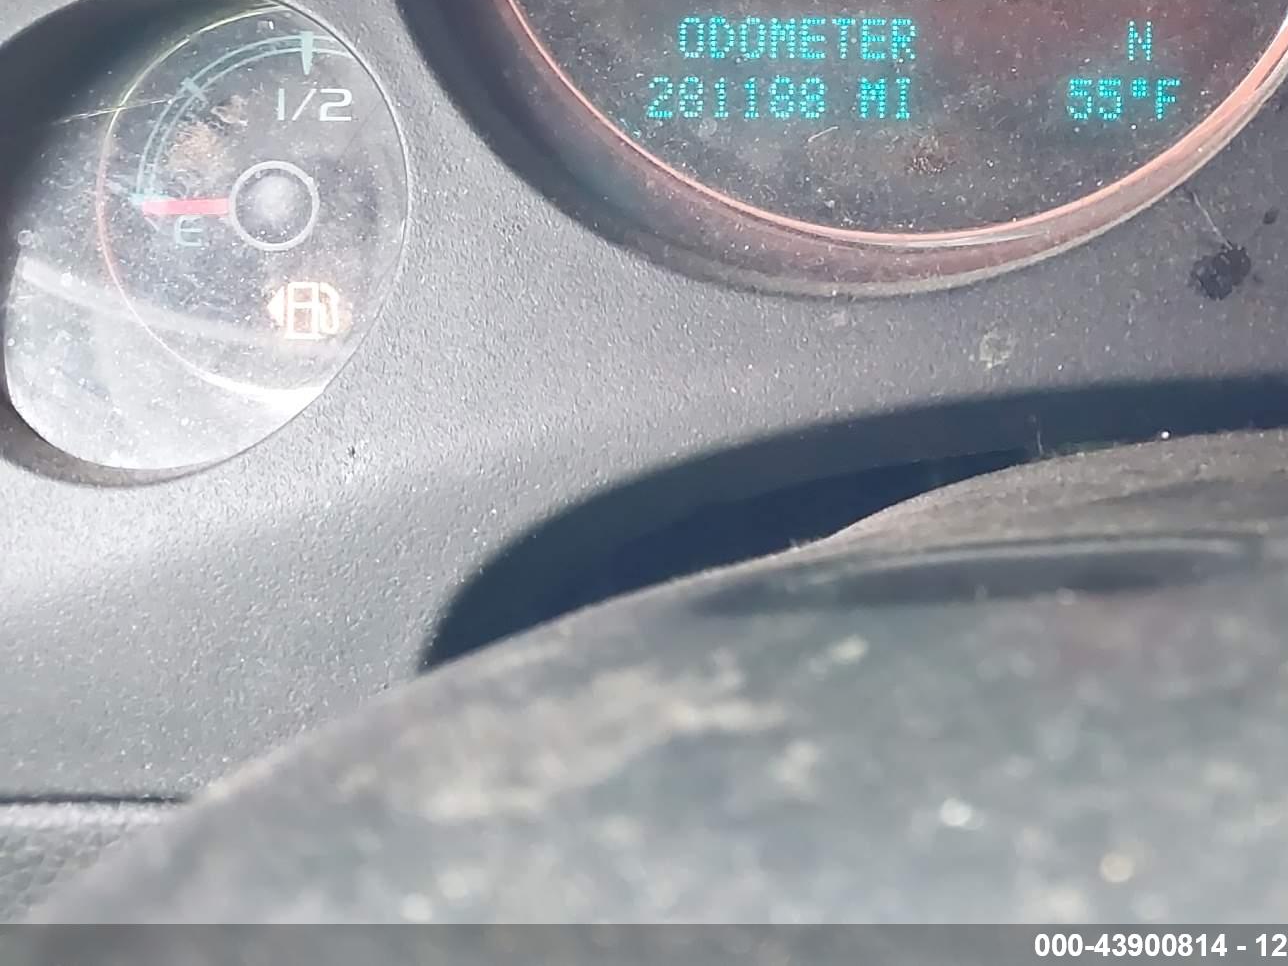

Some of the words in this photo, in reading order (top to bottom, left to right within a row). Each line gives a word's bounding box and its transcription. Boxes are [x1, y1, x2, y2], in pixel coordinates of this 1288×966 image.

[679, 17, 915, 59] ODOMETER
[1128, 20, 1152, 61] N
[278, 89, 352, 122] 1/2
[859, 77, 911, 119] MI
